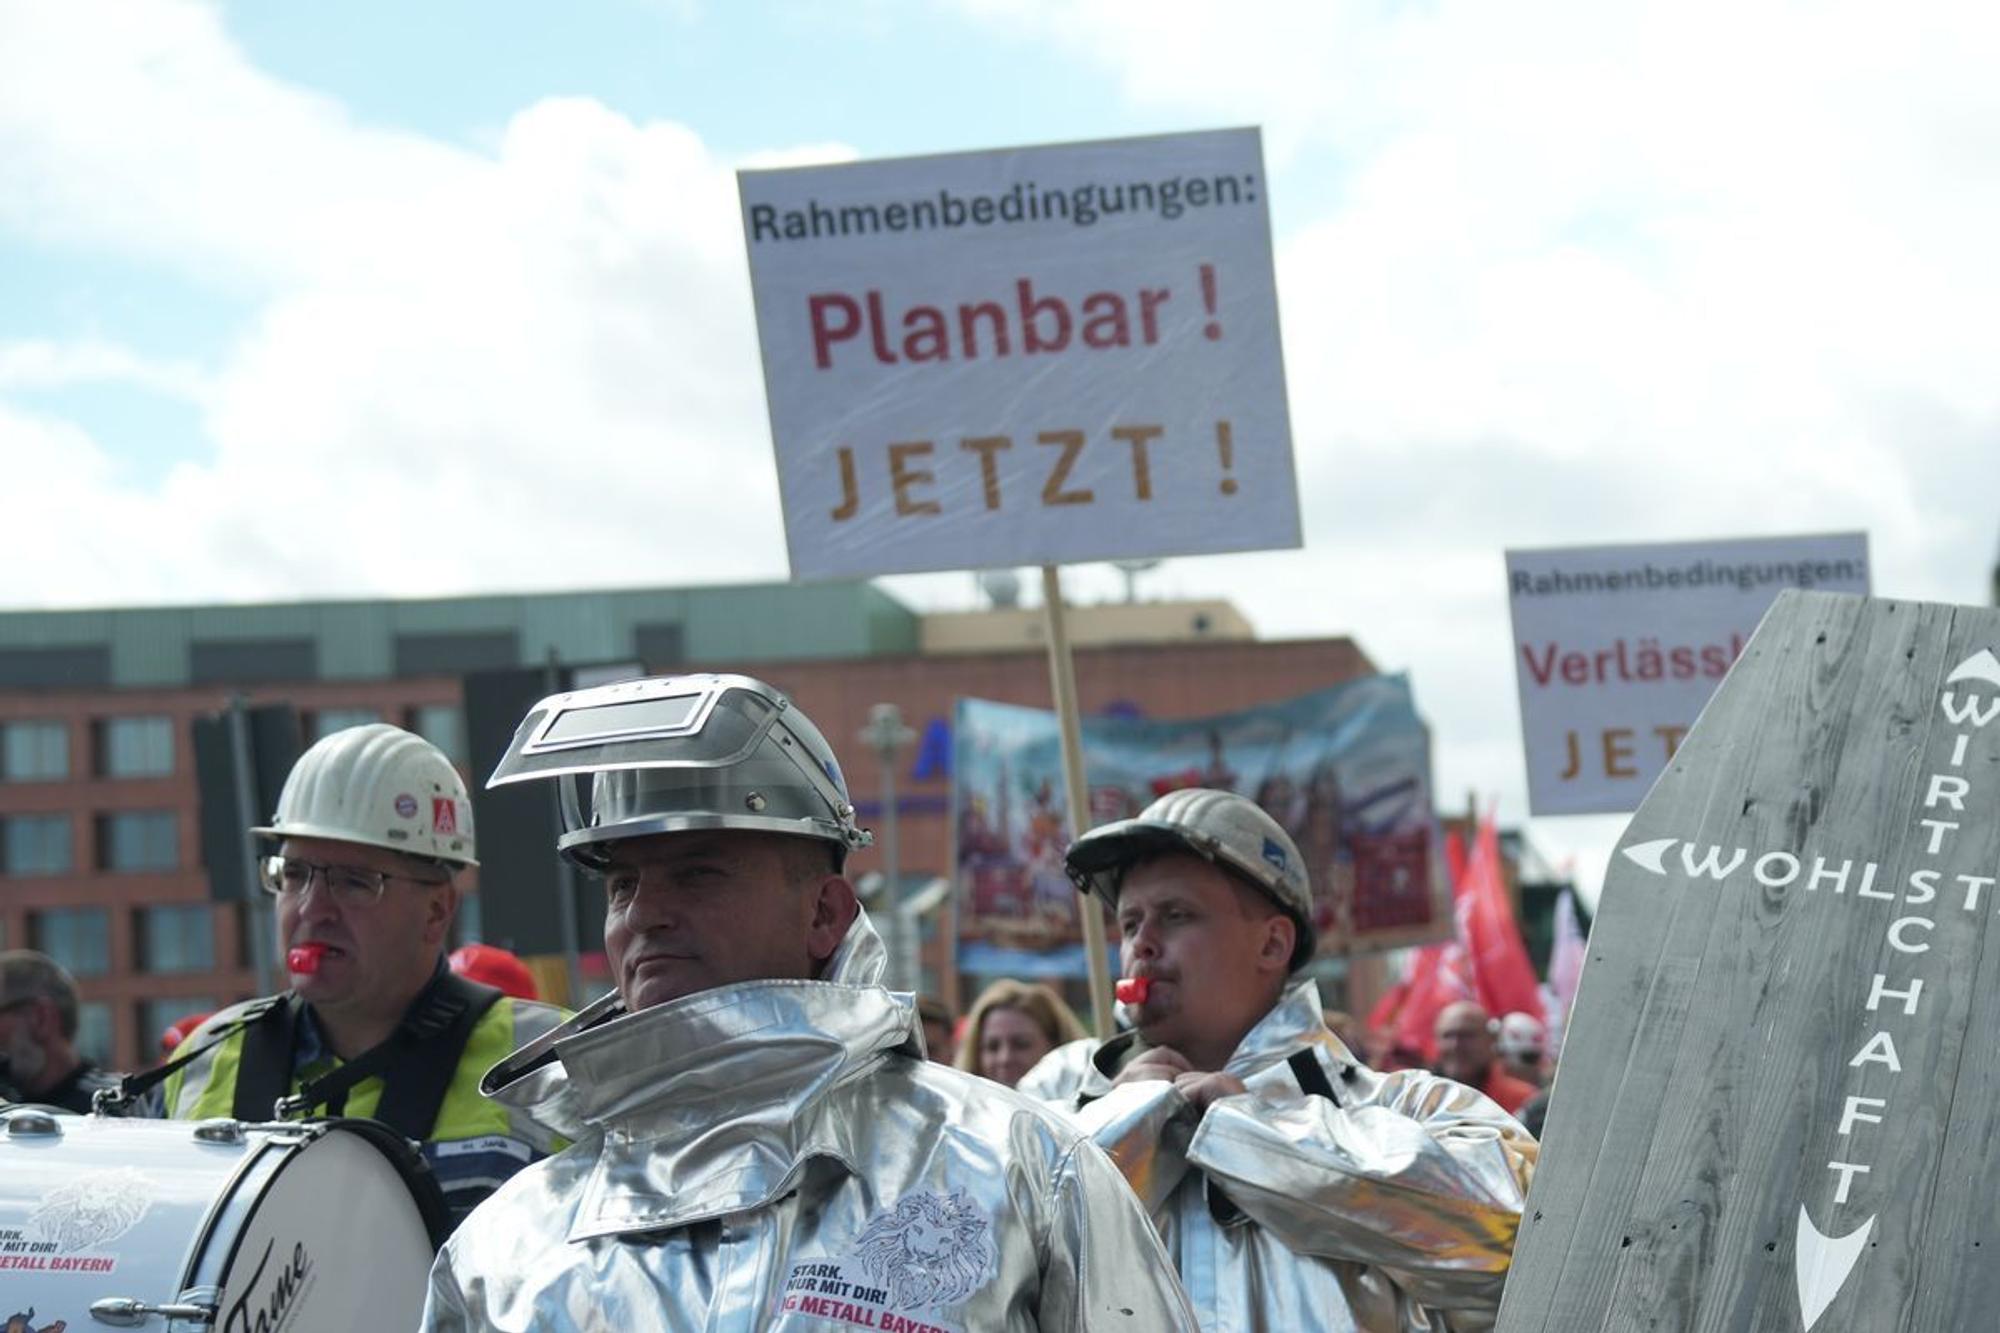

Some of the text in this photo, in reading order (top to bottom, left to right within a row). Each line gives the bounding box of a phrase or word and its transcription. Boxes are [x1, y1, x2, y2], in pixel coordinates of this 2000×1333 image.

[750, 174, 1256, 243] Rahmenbedingungen:
[808, 277, 1171, 369] Planbar
[831, 425, 1163, 522] JETZT
[1511, 557, 1865, 597] Rahmenbedingungen:
[1681, 841, 2000, 915] WOHLST
[0, 1256, 114, 1271] ETALL BAYERN
[3, 1241, 58, 1254] MIT DIR!
[791, 1264, 844, 1281] STARK.
[786, 1278, 888, 1305] NUR MIT DIR!
[800, 1296, 875, 1327] METALL
